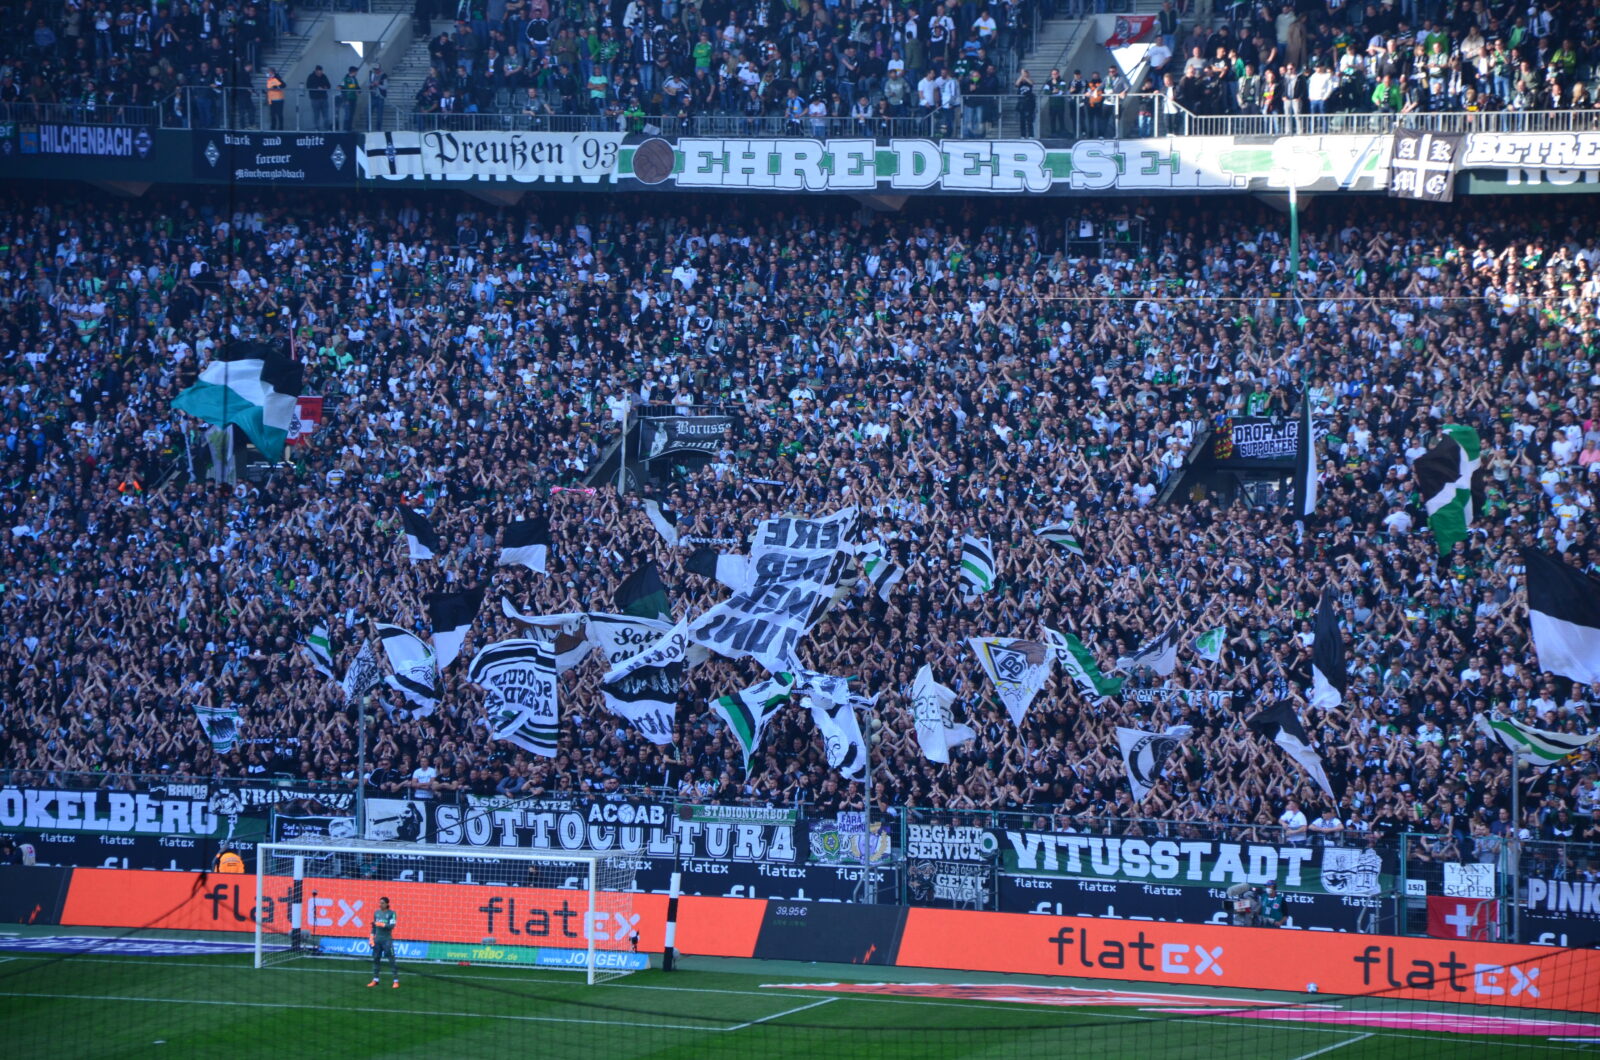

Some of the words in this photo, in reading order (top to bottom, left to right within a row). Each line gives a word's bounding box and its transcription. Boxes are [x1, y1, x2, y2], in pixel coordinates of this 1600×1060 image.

[40, 125, 132, 156] HILCHENBACH
[224, 134, 251, 146] black
[263, 136, 282, 146] and
[296, 136, 325, 149] white
[424, 131, 564, 171] Preußen
[256, 154, 291, 165] forever
[676, 138, 877, 191] EHRE
[890, 138, 1053, 192] DER
[704, 805, 790, 821] STADIONVERBOT
[40, 833, 75, 843] flatex
[99, 835, 135, 845] flatex
[908, 824, 983, 844] BEGLEIT
[159, 837, 195, 848] flatex
[907, 842, 980, 860] SERVICE
[1007, 831, 1313, 886] VITUSSTADT
[681, 860, 729, 874] flatex
[758, 863, 806, 878] flatex
[1014, 877, 1053, 889] flatex
[1459, 874, 1482, 885] IST
[1078, 881, 1117, 893] flatex
[1143, 885, 1182, 896] flatex
[1447, 884, 1494, 897] SUPER
